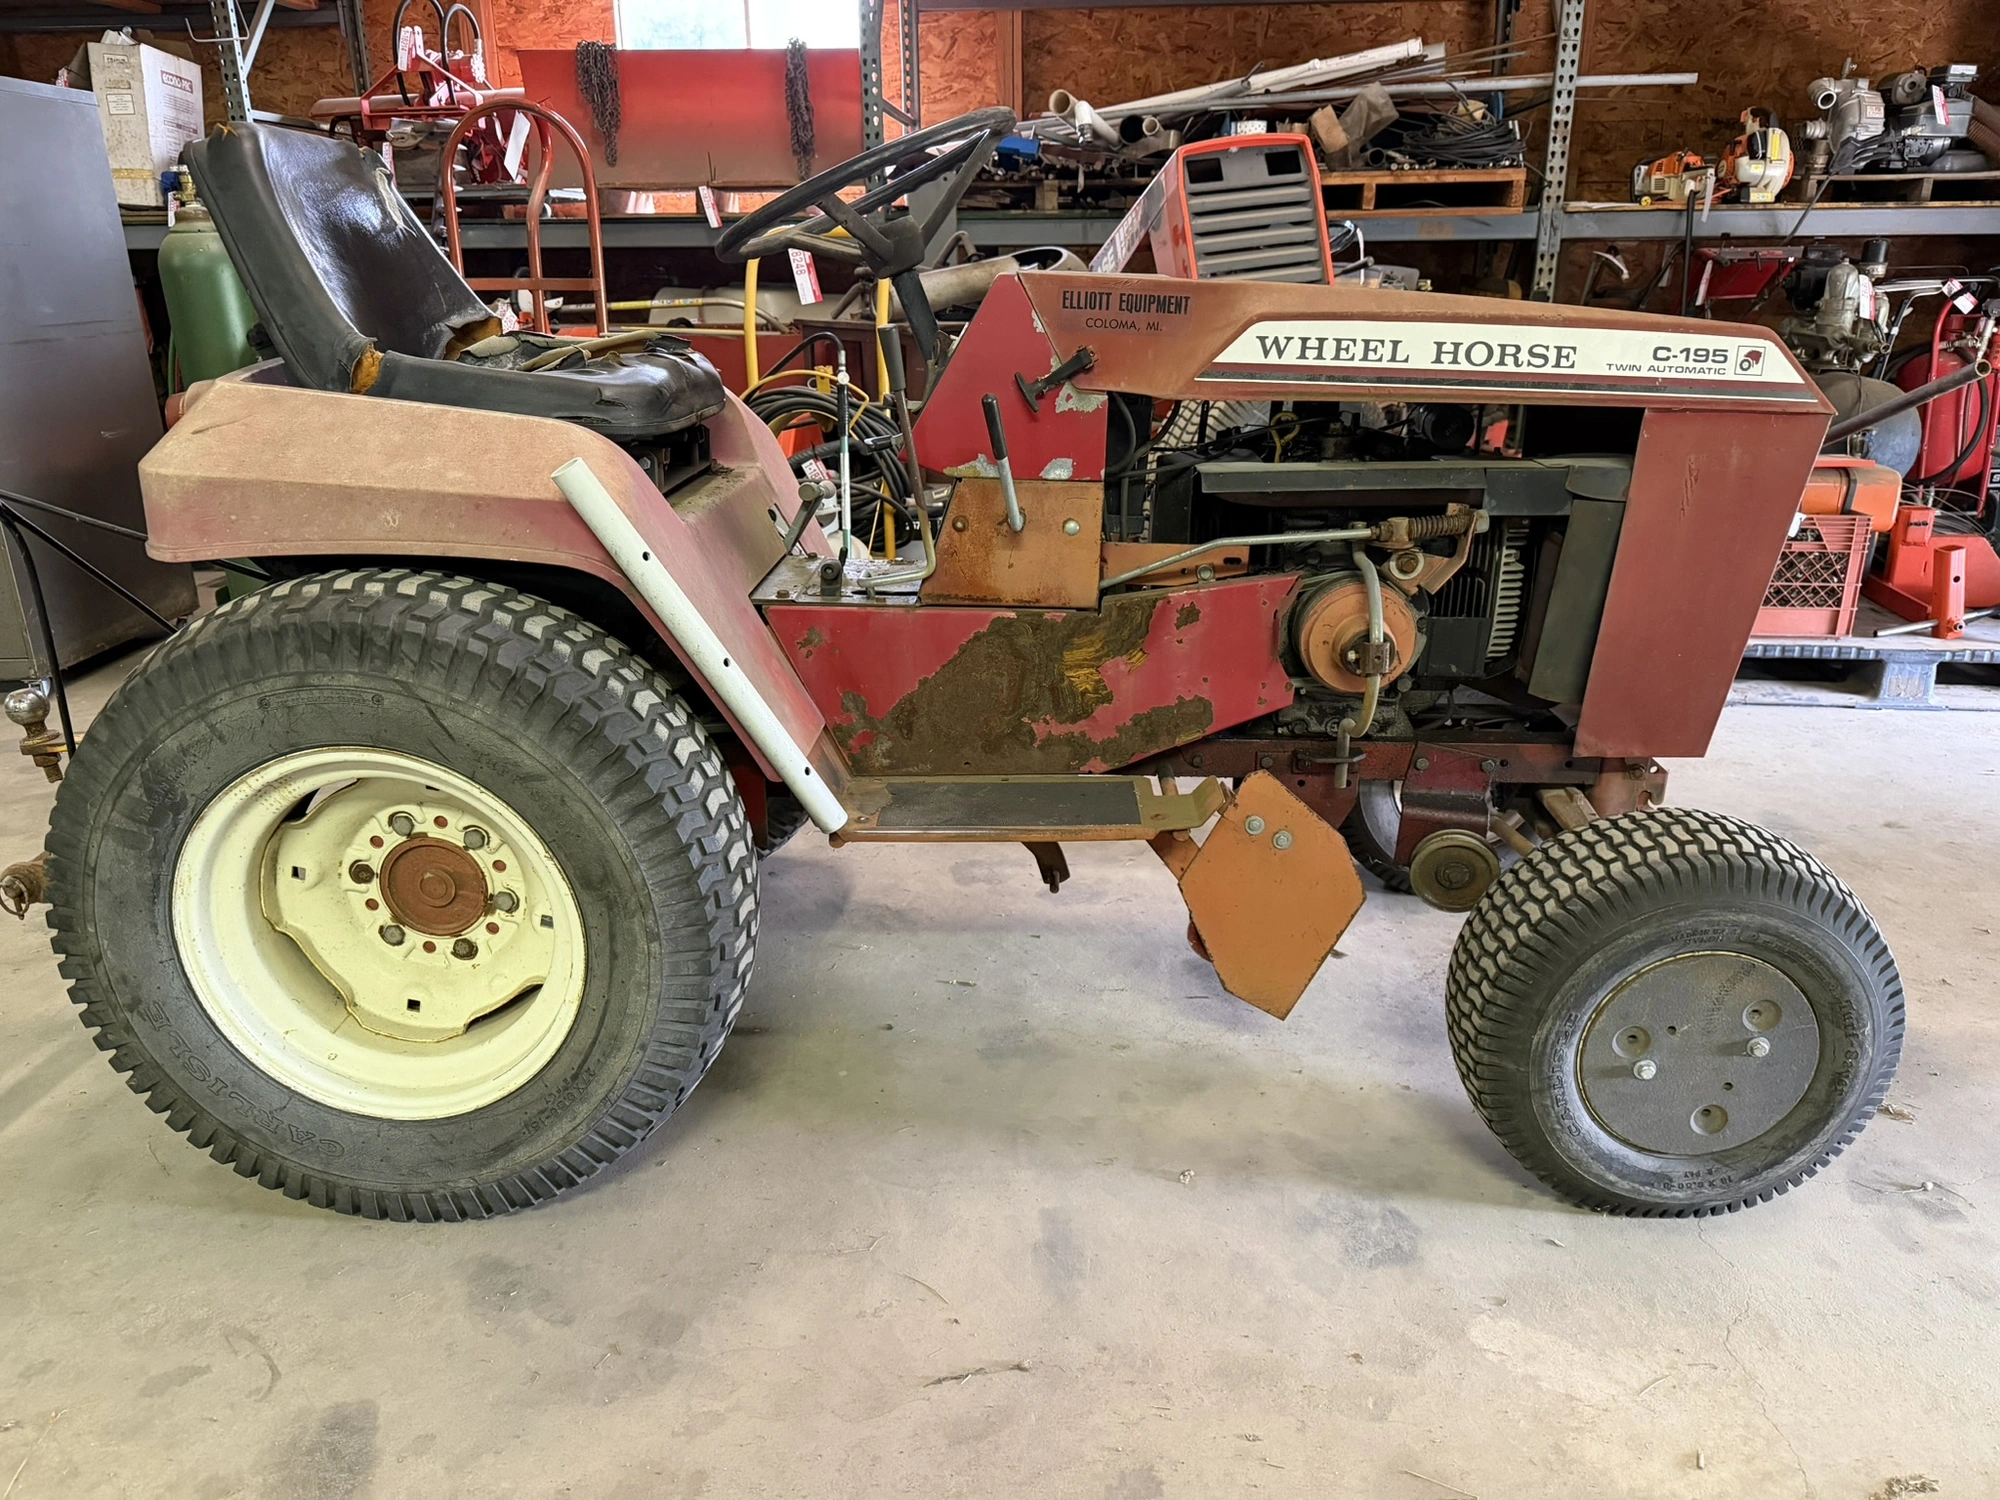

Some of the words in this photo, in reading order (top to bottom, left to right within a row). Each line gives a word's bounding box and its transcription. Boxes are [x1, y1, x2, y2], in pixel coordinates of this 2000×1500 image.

[1062, 290, 1112, 311] ELLIOTT
[1119, 292, 1191, 315] EQUIPMENT
[1085, 317, 1141, 332] COLOMA,
[1145, 321, 1163, 332] MI.
[1256, 335, 1410, 363] WHEEL
[1431, 341, 1577, 369] HORSE
[1652, 346, 1729, 364] C-195
[1606, 363, 1642, 372] TWIN
[1647, 364, 1727, 376] AUTOMATIC
[143, 1001, 346, 1158] CARLISLE
[1551, 1011, 1581, 1137] CARLISLE
